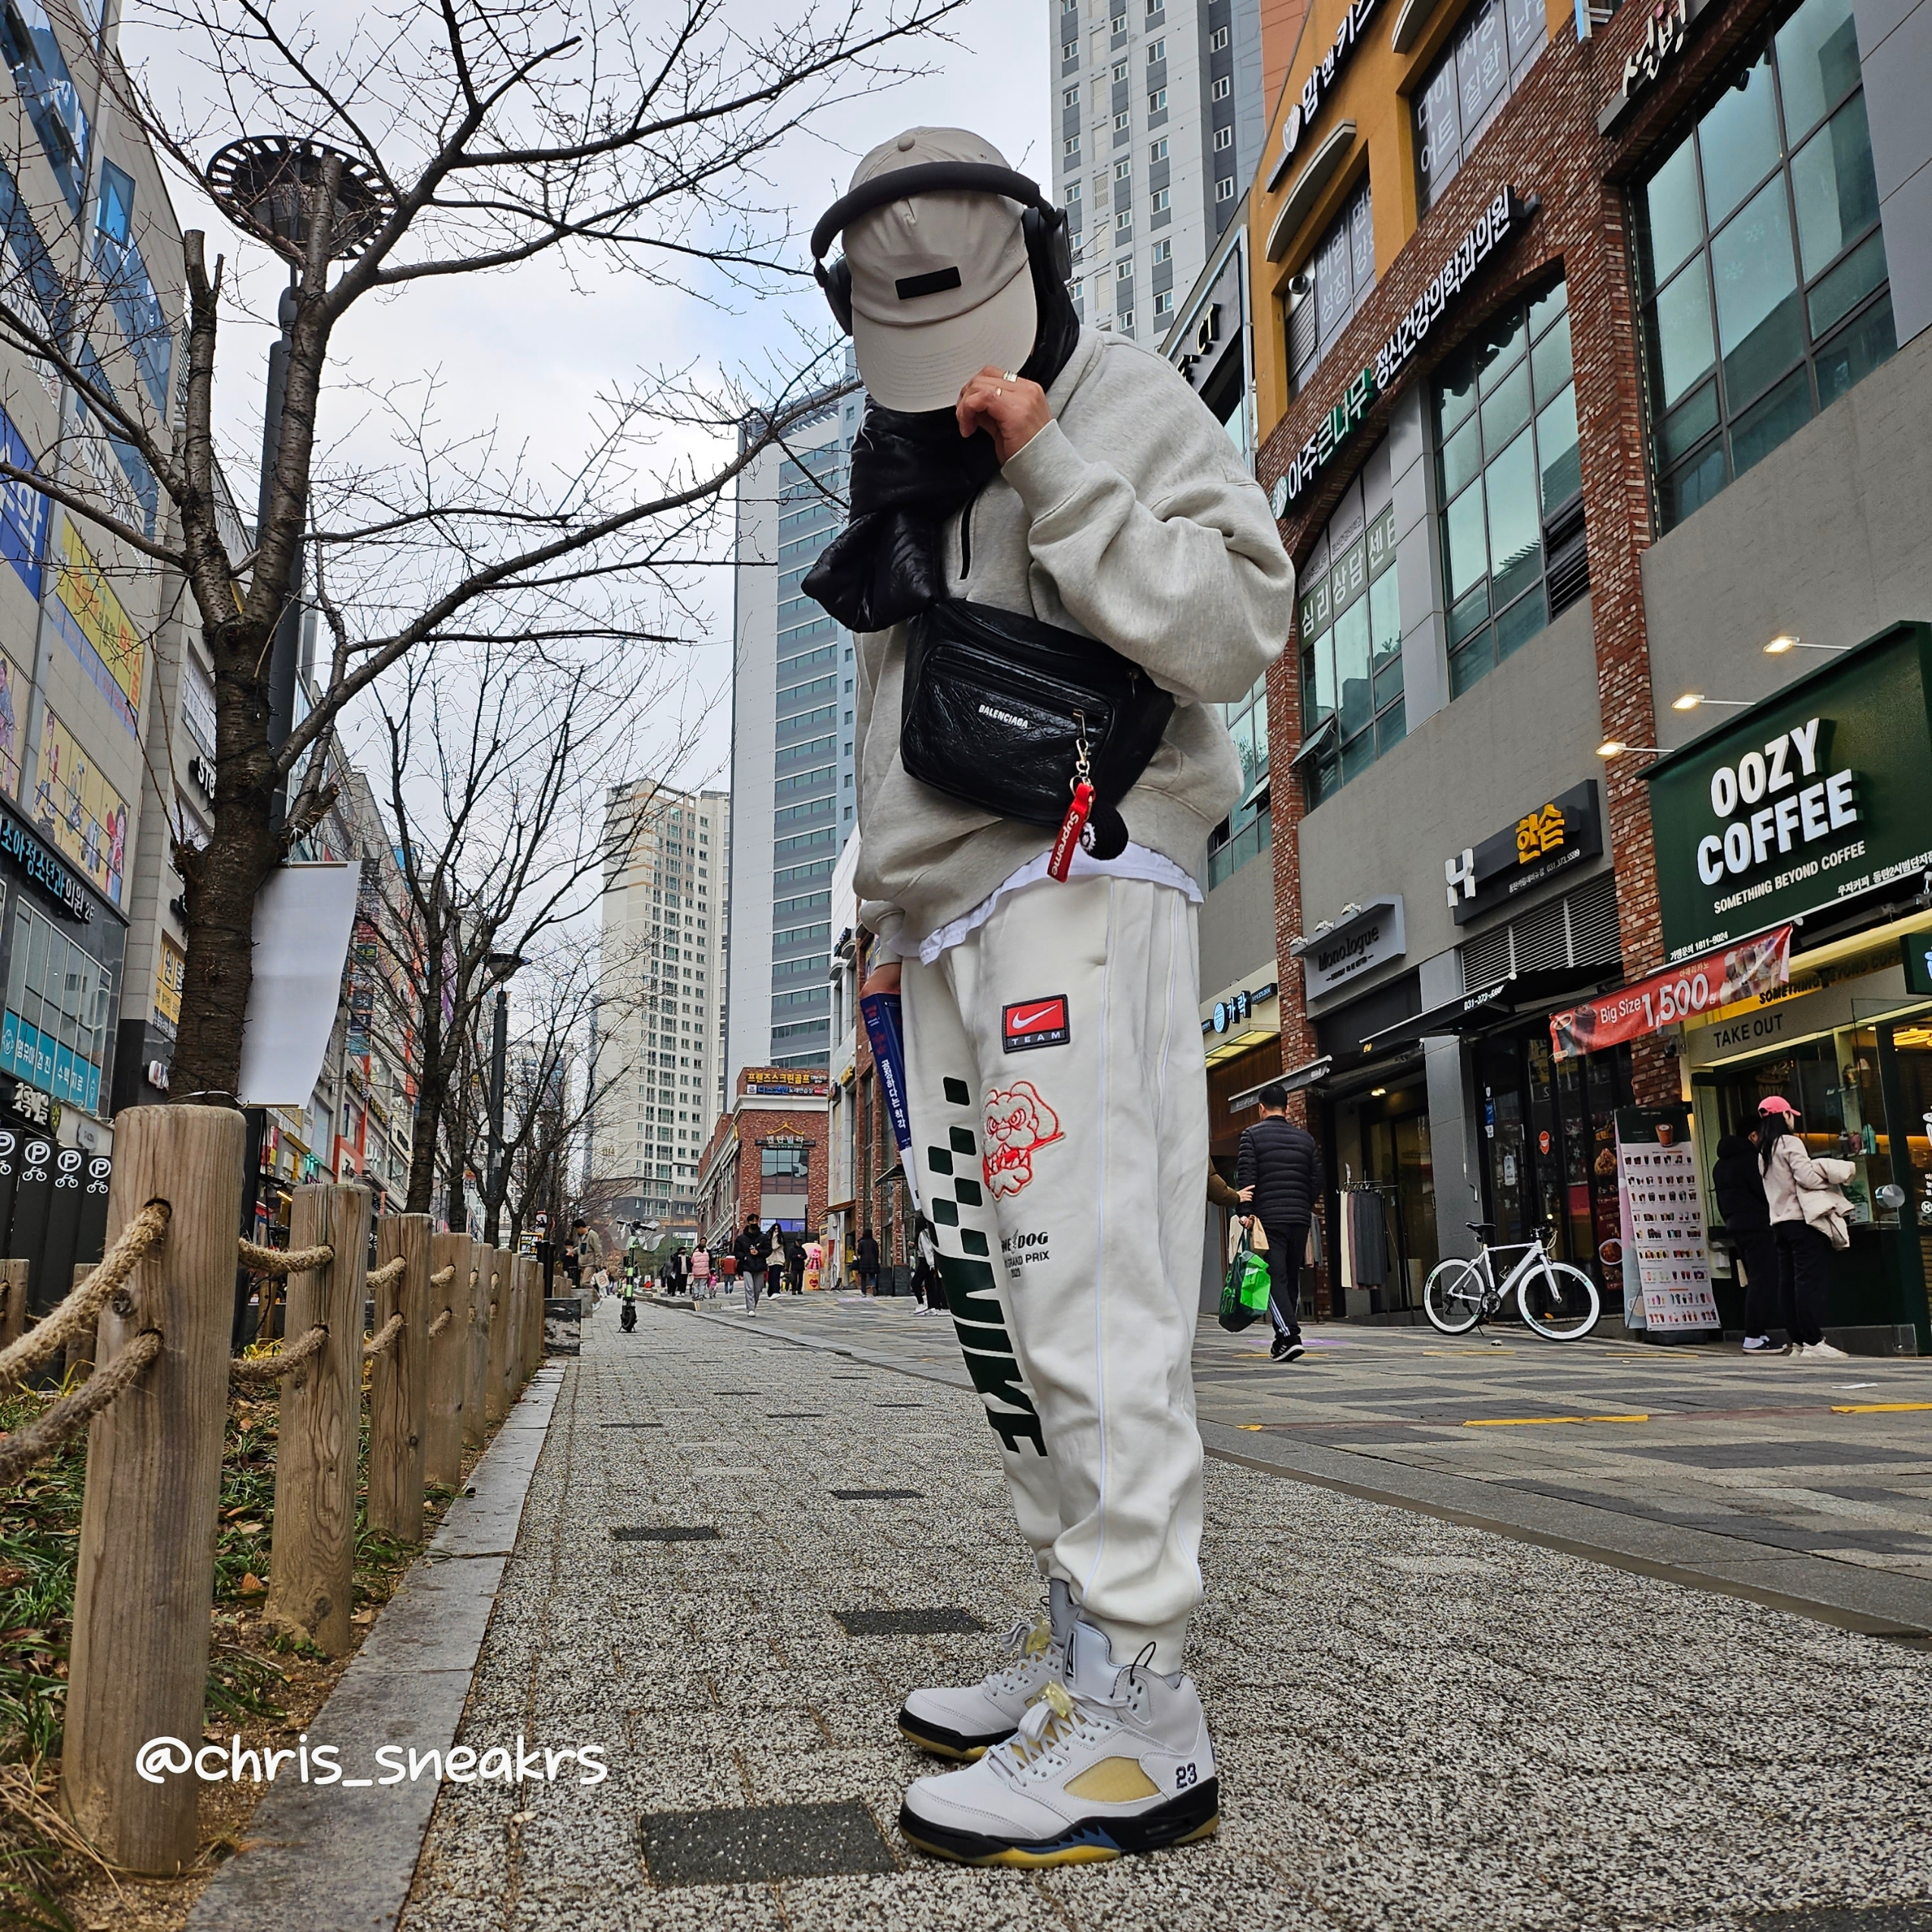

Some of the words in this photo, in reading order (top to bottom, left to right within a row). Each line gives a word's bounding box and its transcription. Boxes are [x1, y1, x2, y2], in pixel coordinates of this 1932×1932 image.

[1418, 61, 1452, 131] 다이
[1464, 39, 1501, 115] 질환
[1421, 109, 1455, 173] 어트
[1319, 225, 1345, 281] 비염
[1321, 268, 1348, 323] 성장
[1376, 185, 1510, 390] 정신건강의학과의원
[978, 704, 1029, 728] BALENCIAGA
[1710, 717, 1820, 818] OOZY
[1052, 810, 1079, 876] Supreme
[1515, 804, 1565, 864] 한솥
[1697, 768, 1858, 886] COFFEE
[1713, 878, 1773, 914] SOMETHING
[1774, 860, 1819, 890] BEYOND
[1820, 840, 1866, 870] COFFEE
[1837, 874, 1870, 896] 우지커피
[1318, 926, 1380, 972] Monologue
[1669, 944, 1694, 961] 가맹문의
[1695, 930, 1729, 951] 1811-9024
[1227, 991, 1247, 1023] 가락
[1600, 1005, 1618, 1024] Big
[1619, 997, 1641, 1018] Size
[1641, 973, 1708, 1027] 1,500
[1709, 993, 1716, 1005] 원
[1759, 973, 1820, 1005] SOMETHING
[1012, 1031, 1061, 1046] TEAM
[1713, 1024, 1750, 1049] TAKE
[1753, 1013, 1783, 1037] OUT
[747, 1072, 810, 1084] 프렌즈스크린골프
[895, 1108, 906, 1129] 착각
[1018, 1232, 1049, 1249] DOG
[1025, 1251, 1049, 1264] PRIX
[1175, 1762, 1198, 1789] 23
